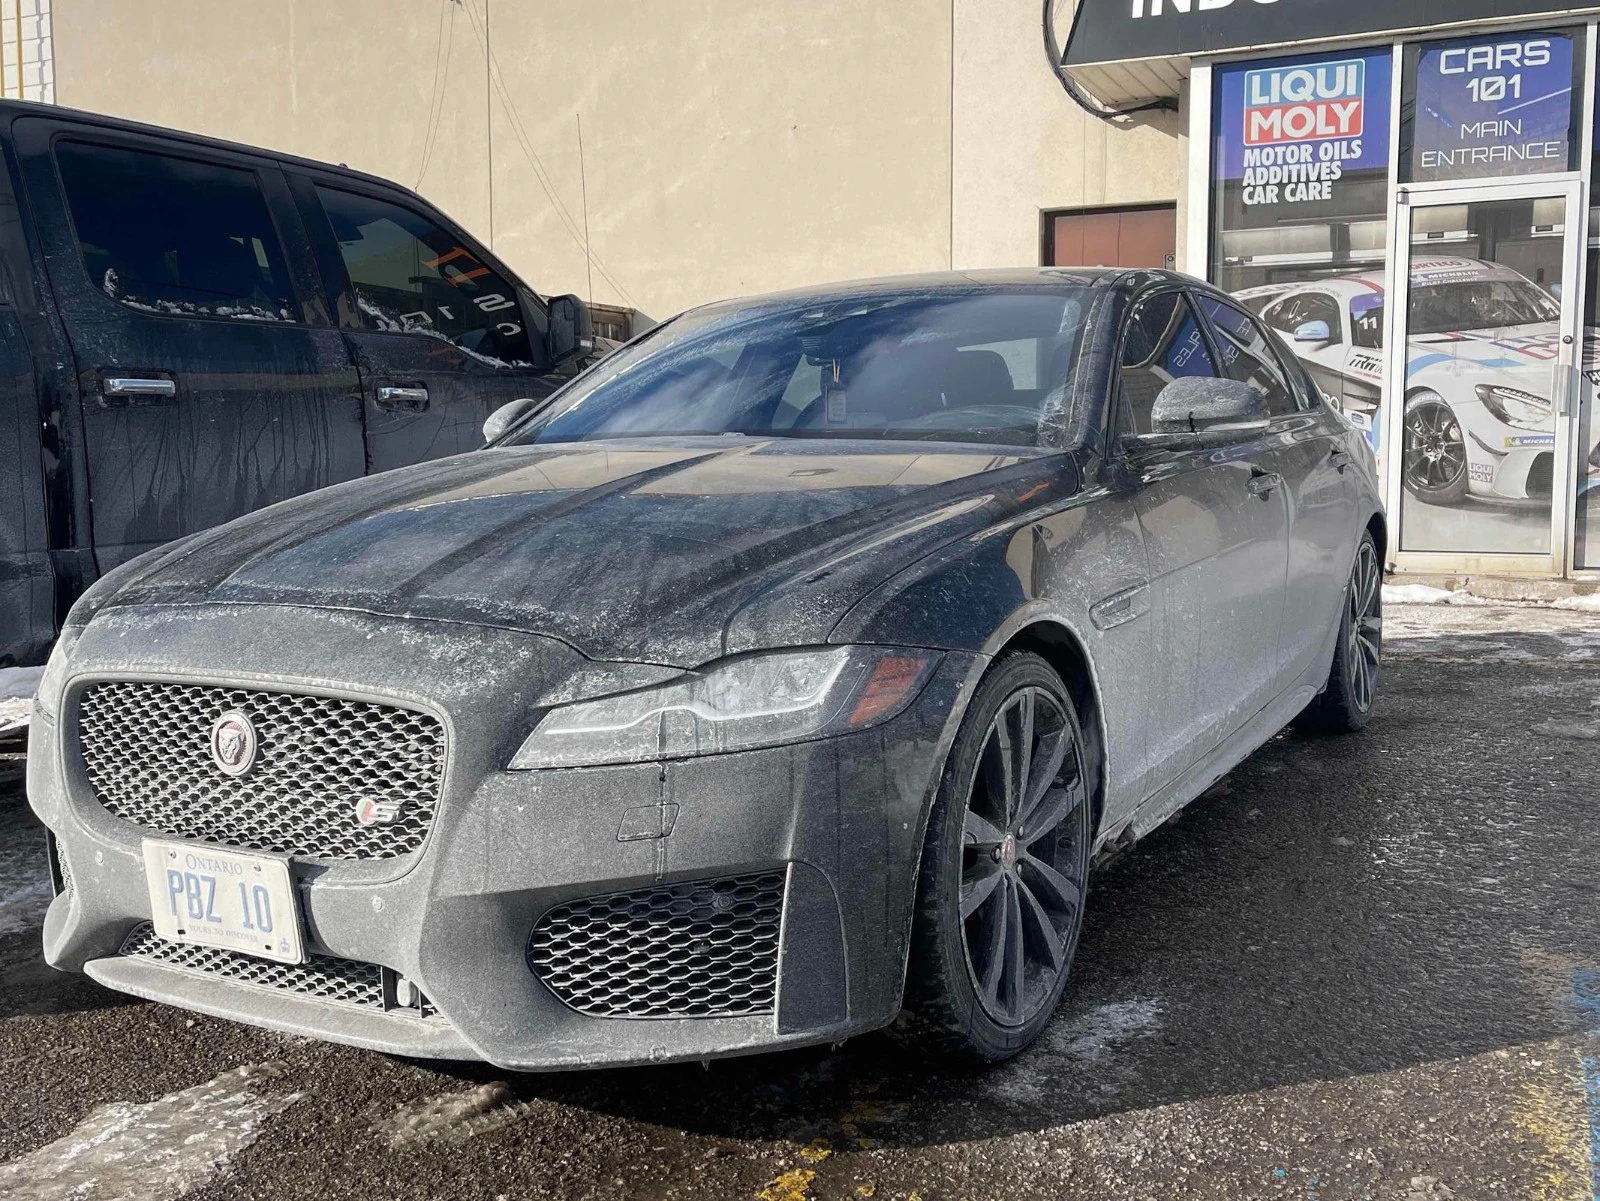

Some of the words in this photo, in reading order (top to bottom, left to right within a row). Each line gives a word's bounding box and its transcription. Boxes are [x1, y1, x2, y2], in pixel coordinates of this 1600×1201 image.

[1439, 40, 1551, 75] CARS
[1251, 64, 1358, 106] LIQUI
[1465, 73, 1521, 103] 101
[1250, 101, 1361, 141] MOLY
[1460, 118, 1522, 140] MAIN
[1243, 144, 1314, 168] MOTOR
[1318, 139, 1363, 162] OILS
[1421, 141, 1561, 168] ENTRANCE
[1242, 160, 1342, 187] ADDITIVES
[1242, 185, 1279, 206] CAR
[1284, 181, 1332, 203] CARE
[1428, 270, 1479, 279] MICHELIN
[1359, 316, 1378, 330] 11
[1469, 463, 1493, 473] LIQUI
[1469, 472, 1492, 482] MOLY
[167, 869, 222, 923] PBZ
[239, 881, 273, 933] 10
[188, 923, 213, 935] YOURS
[215, 927, 224, 936] TO
[225, 930, 259, 943] DISCOVER
